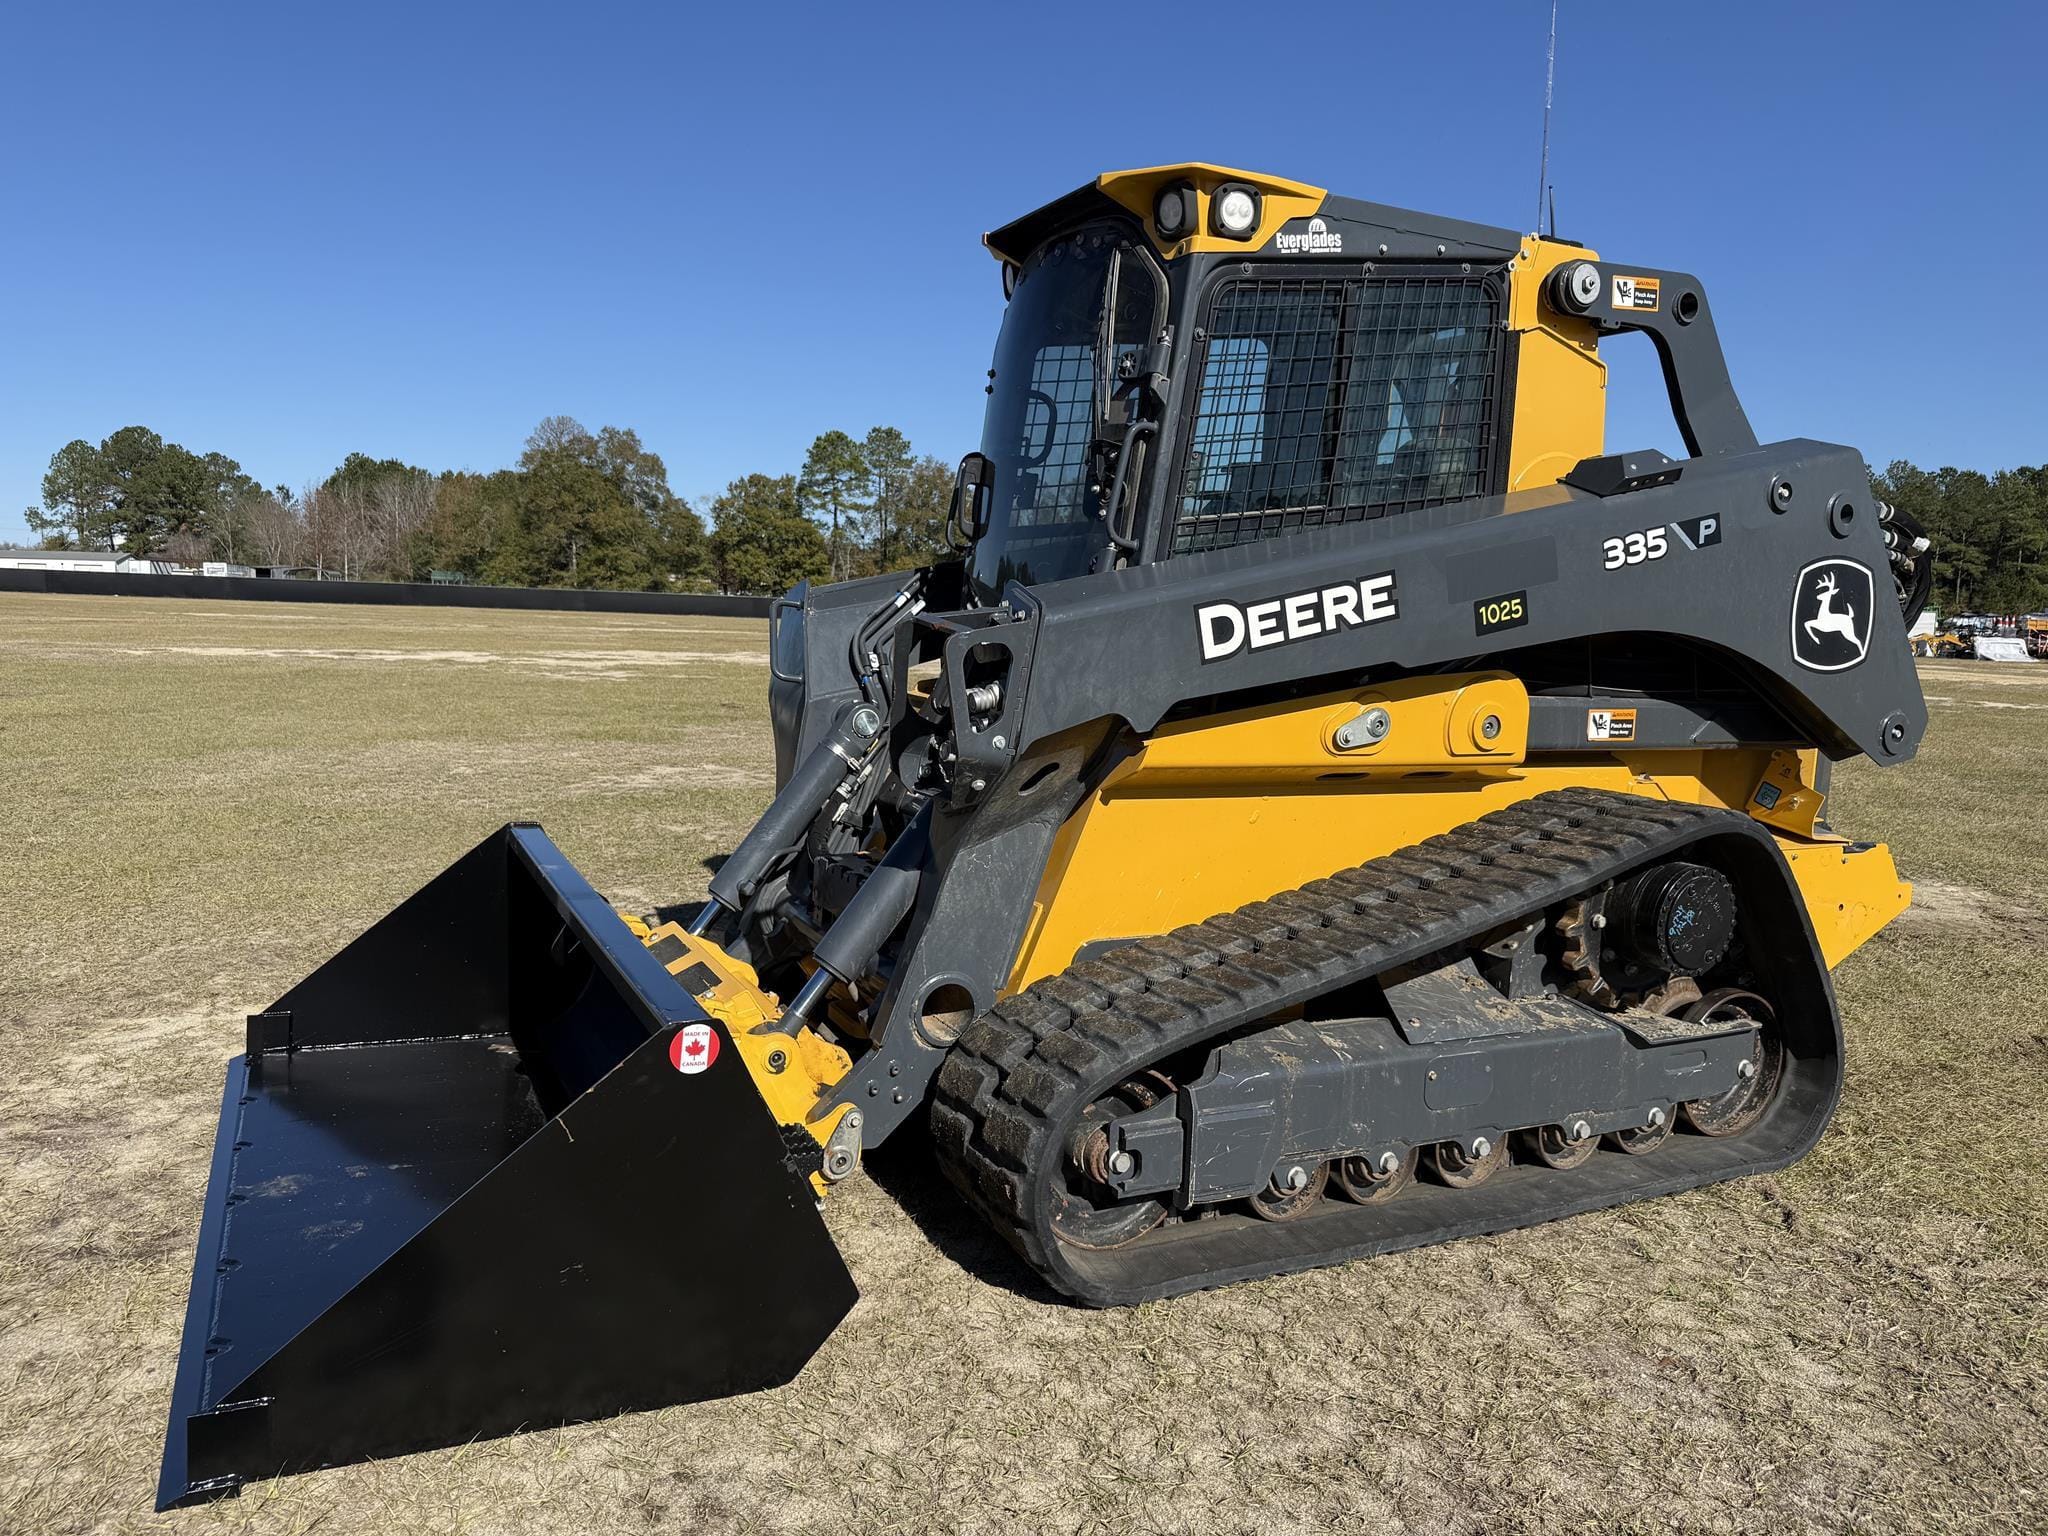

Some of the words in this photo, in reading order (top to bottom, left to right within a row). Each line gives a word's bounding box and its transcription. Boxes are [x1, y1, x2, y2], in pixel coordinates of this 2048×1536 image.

[1276, 231, 1342, 251] Everglades
[1603, 526, 1668, 571] 335
[1198, 574, 1396, 660] DEERE
[1479, 598, 1523, 626] 1025
